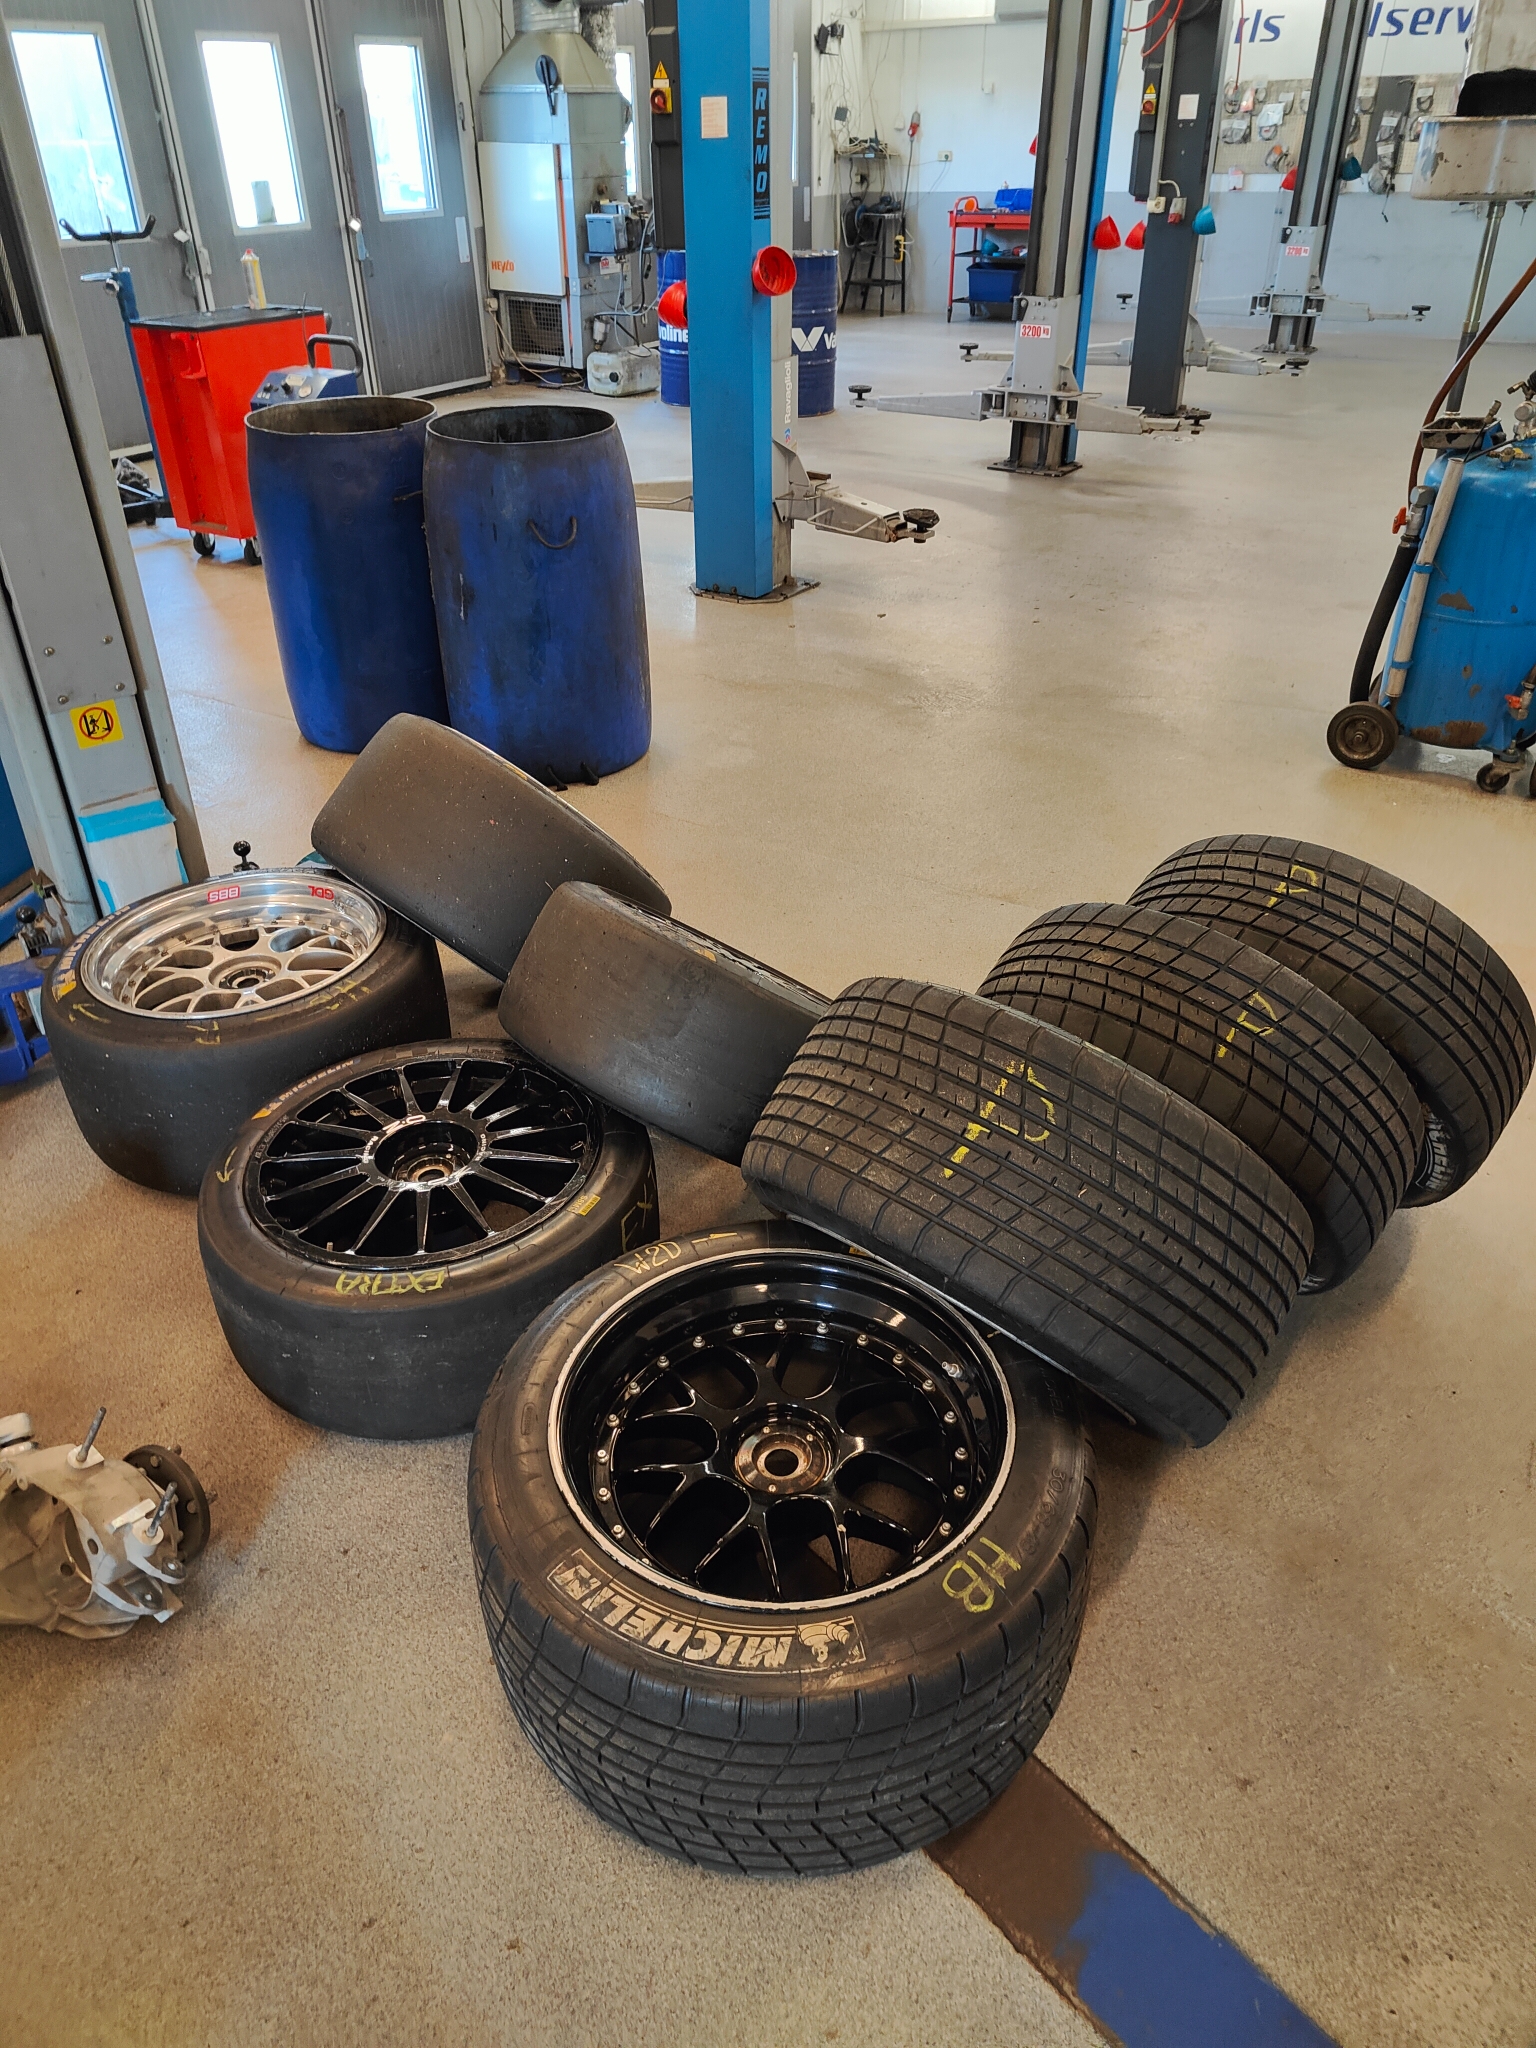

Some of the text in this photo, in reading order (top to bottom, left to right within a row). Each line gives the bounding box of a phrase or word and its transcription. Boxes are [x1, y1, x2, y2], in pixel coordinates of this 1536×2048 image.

[754, 87, 768, 193] REMO
[491, 260, 515, 273] HEYLO
[1021, 324, 1050, 337] 3200 kg
[784, 360, 792, 425] Ravaglioli
[208, 886, 240, 902] BBS
[308, 885, 335, 901] GDL
[60, 905, 131, 970] MICHELIN
[278, 1059, 354, 1102] MICHELIN
[613, 1240, 682, 1275] W2D
[335, 1269, 445, 1296] EXTRA
[942, 1536, 1022, 1613] HB
[555, 1563, 793, 1668] MICHELIN
